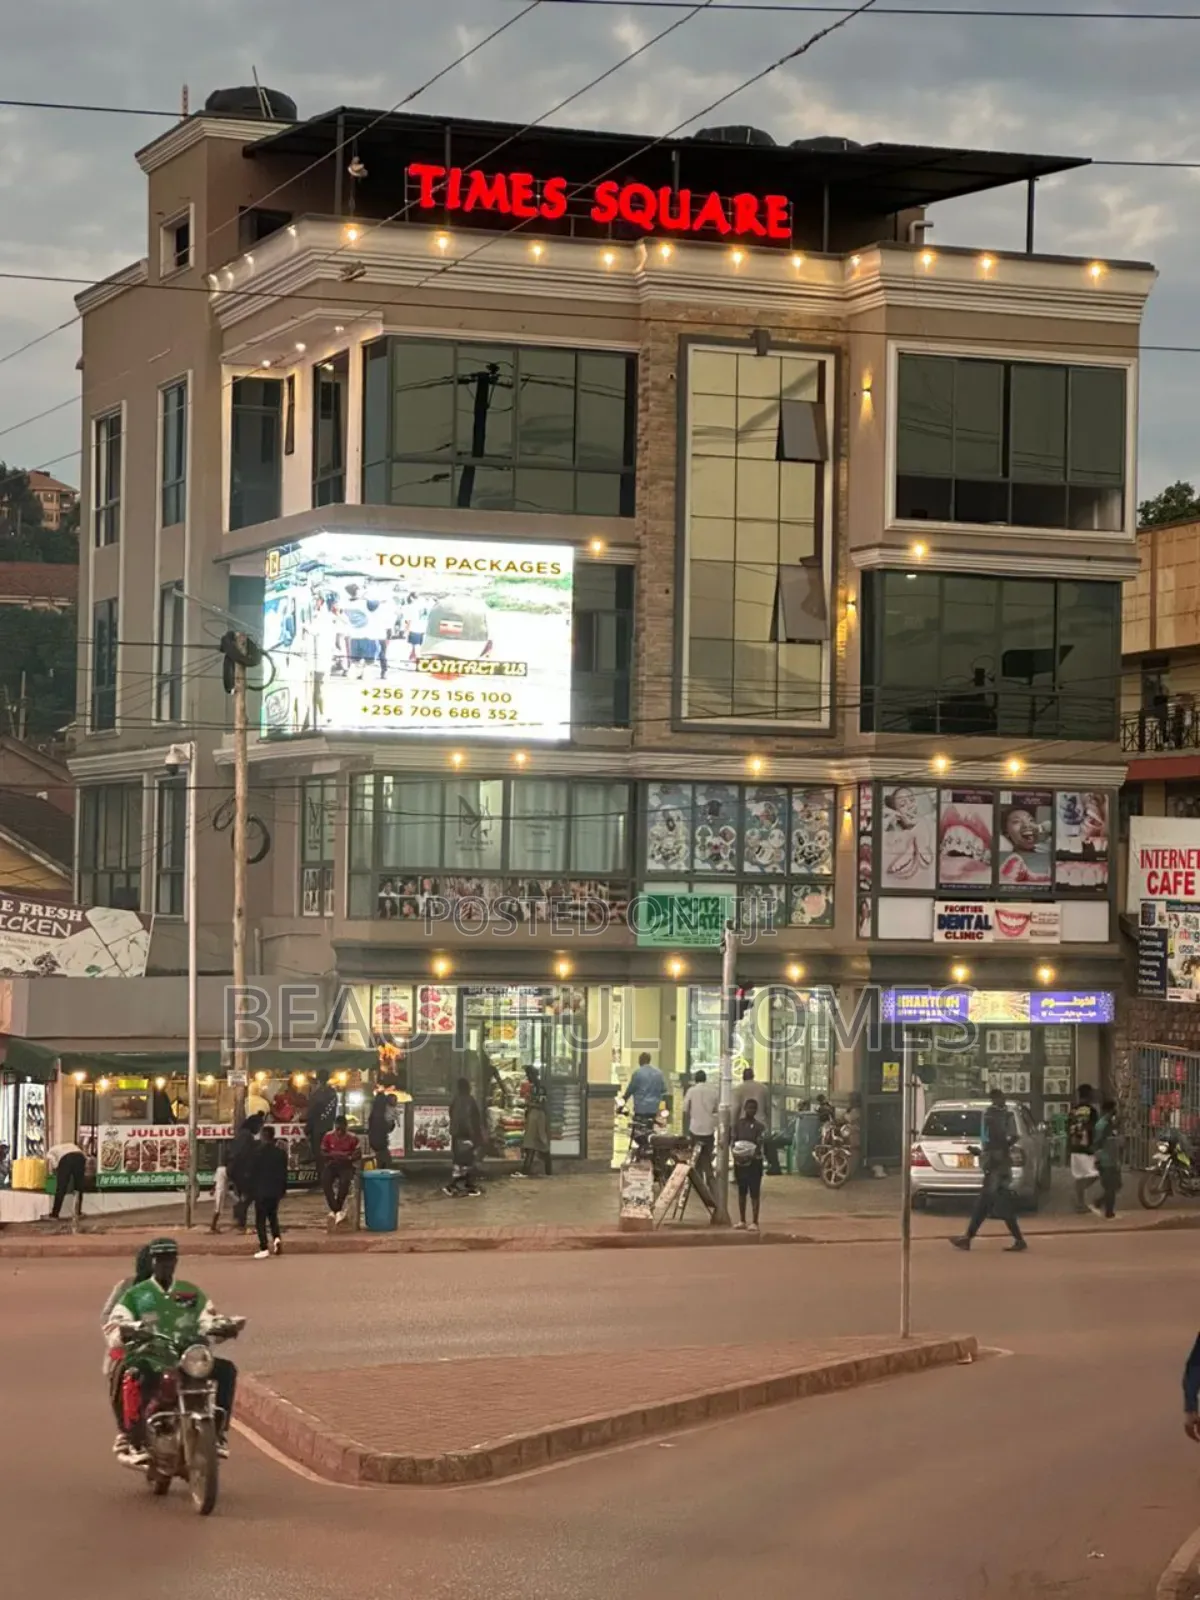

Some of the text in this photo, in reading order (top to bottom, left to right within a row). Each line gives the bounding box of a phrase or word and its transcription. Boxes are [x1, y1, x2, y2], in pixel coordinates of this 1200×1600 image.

[408, 163, 792, 239] TIMES SQUARE
[376, 553, 561, 575] TOUR PACKAGES
[361, 688, 512, 703] +256 775 156 100
[361, 704, 518, 720] +256 706 686 352
[1147, 871, 1195, 895] CAFE
[19, 902, 82, 921] FRESH
[937, 914, 992, 930] DENTAL
[944, 931, 984, 940] CLINIC
[127, 1126, 186, 1137] JULIUS
